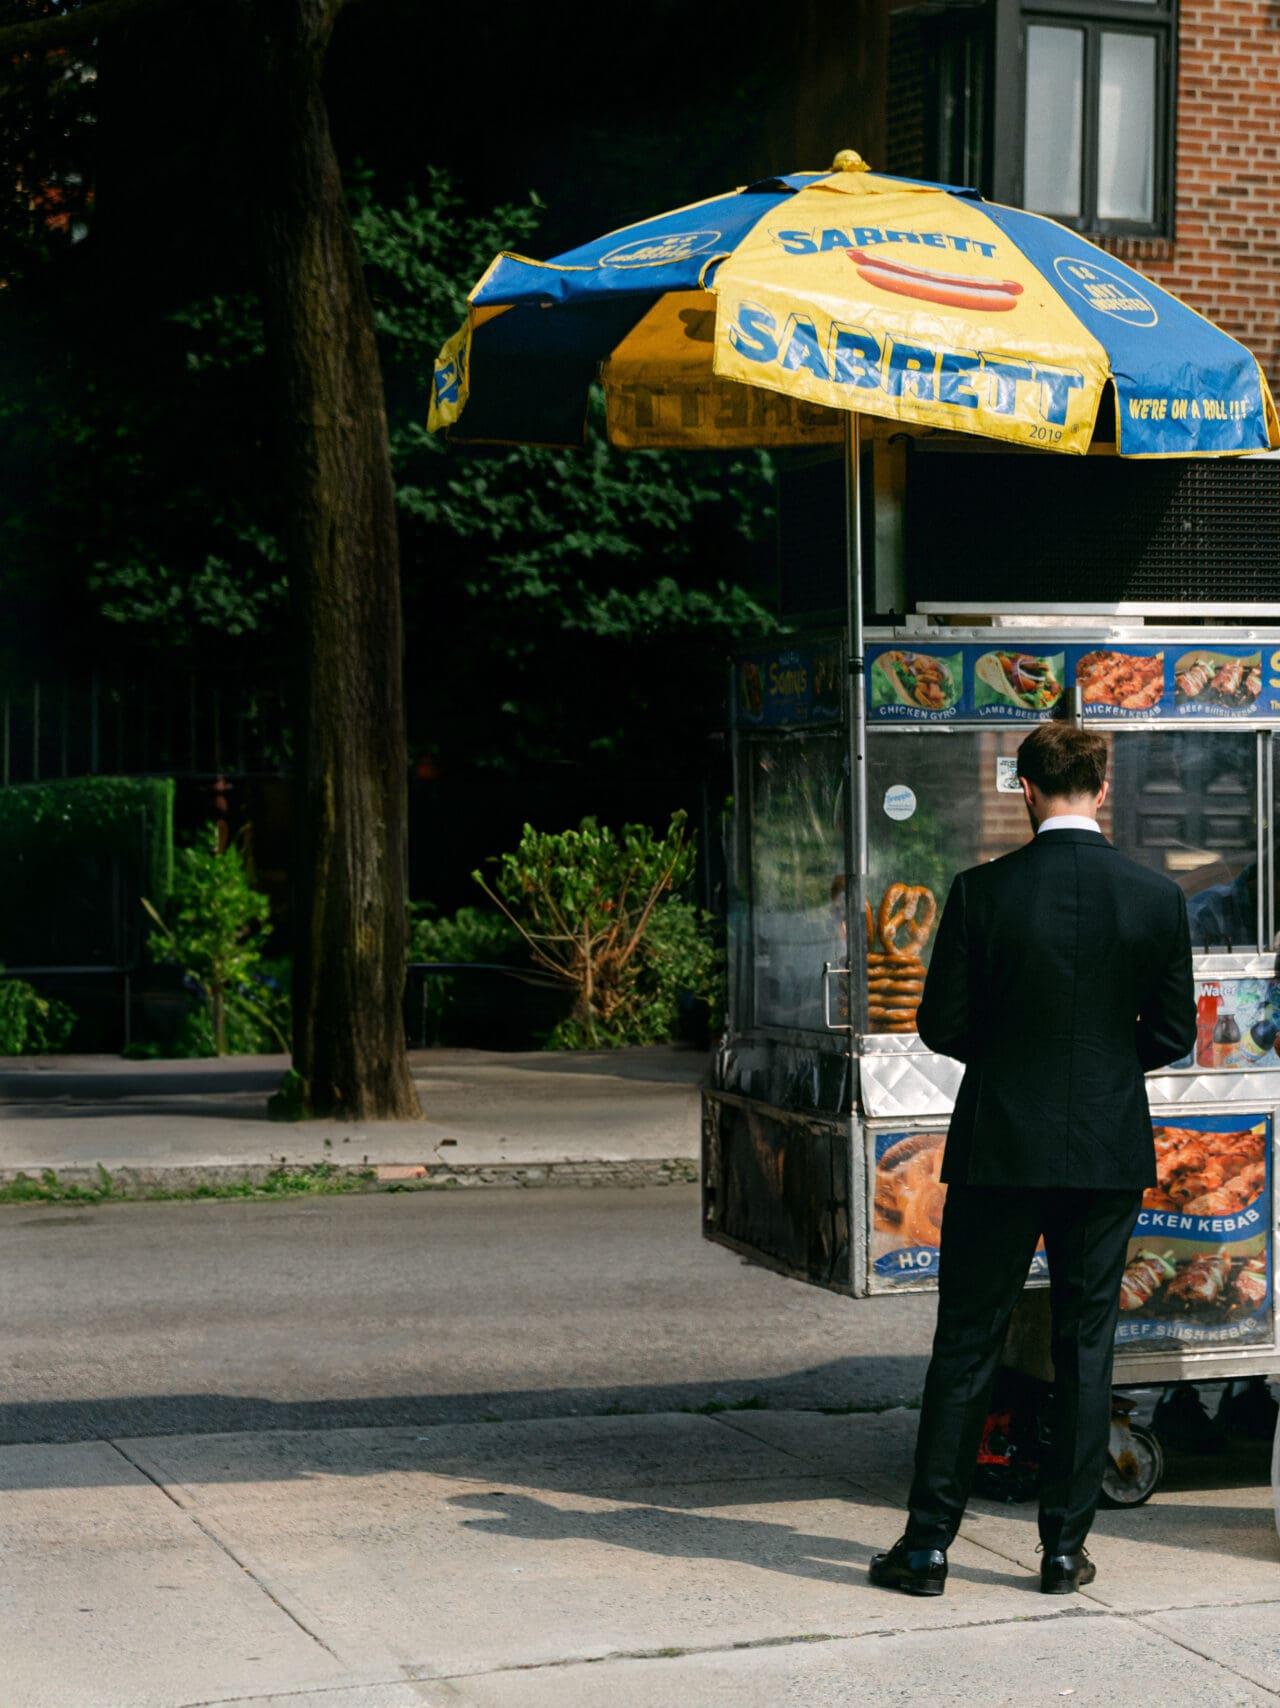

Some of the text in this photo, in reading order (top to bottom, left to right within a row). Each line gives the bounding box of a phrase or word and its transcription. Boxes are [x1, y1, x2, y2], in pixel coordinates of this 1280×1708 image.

[768, 224, 999, 259] SABRETT
[729, 301, 1085, 426] SABRETT
[1129, 398, 1168, 420] WE'RE
[1171, 399, 1188, 420] ON
[1191, 400, 1201, 419] A
[1202, 398, 1228, 420] ROLL
[1028, 423, 1063, 444] 2019
[879, 703, 957, 720] CHICKEN GYRO
[979, 706, 1005, 716] LAMB
[1007, 707, 1013, 715] &
[1015, 709, 1037, 720] BEEF
[1084, 705, 1162, 719] HICKEN KEBAB
[1178, 704, 1201, 715] BEEF
[1199, 984, 1236, 997] Water
[1138, 1208, 1260, 1233] CKEN KEBAB
[898, 1250, 940, 1269] HO
[1119, 1323, 1150, 1337] EEF
[1208, 1318, 1257, 1340] KEBAB
